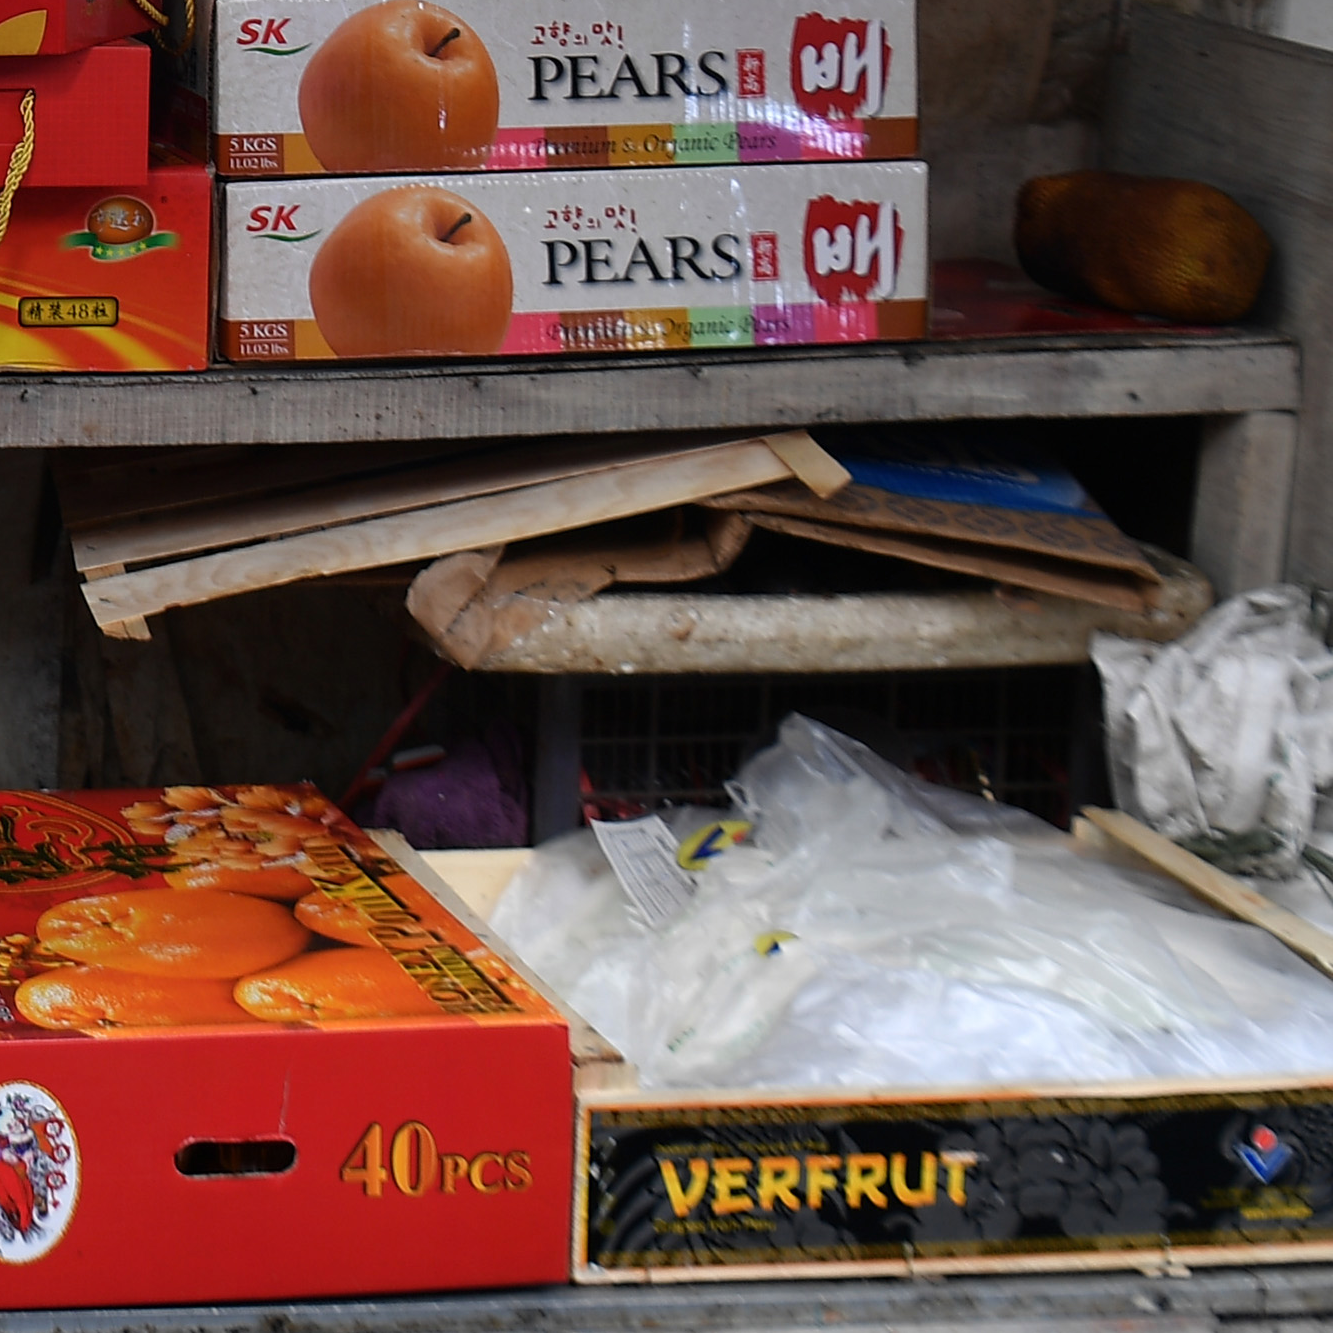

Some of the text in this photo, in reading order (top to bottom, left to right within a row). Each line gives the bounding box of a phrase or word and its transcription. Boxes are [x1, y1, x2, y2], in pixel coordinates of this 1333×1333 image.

[236, 17, 292, 46] SK
[531, 22, 589, 49] 고향의
[528, 51, 728, 103] PEARS
[229, 136, 278, 152] 5 KGS
[533, 134, 618, 157] Premium
[642, 133, 720, 157] Organic
[723, 131, 778, 152] Pears
[229, 156, 280, 170] 11.02 lbs
[245, 203, 303, 234] SK
[544, 208, 603, 234] 고향의
[542, 232, 743, 287] PEARS
[239, 322, 288, 338] 5 KGS
[660, 316, 734, 343] Organic
[238, 342, 290, 355] 11.02 lbs
[658, 1151, 981, 1218] VERFRUT
